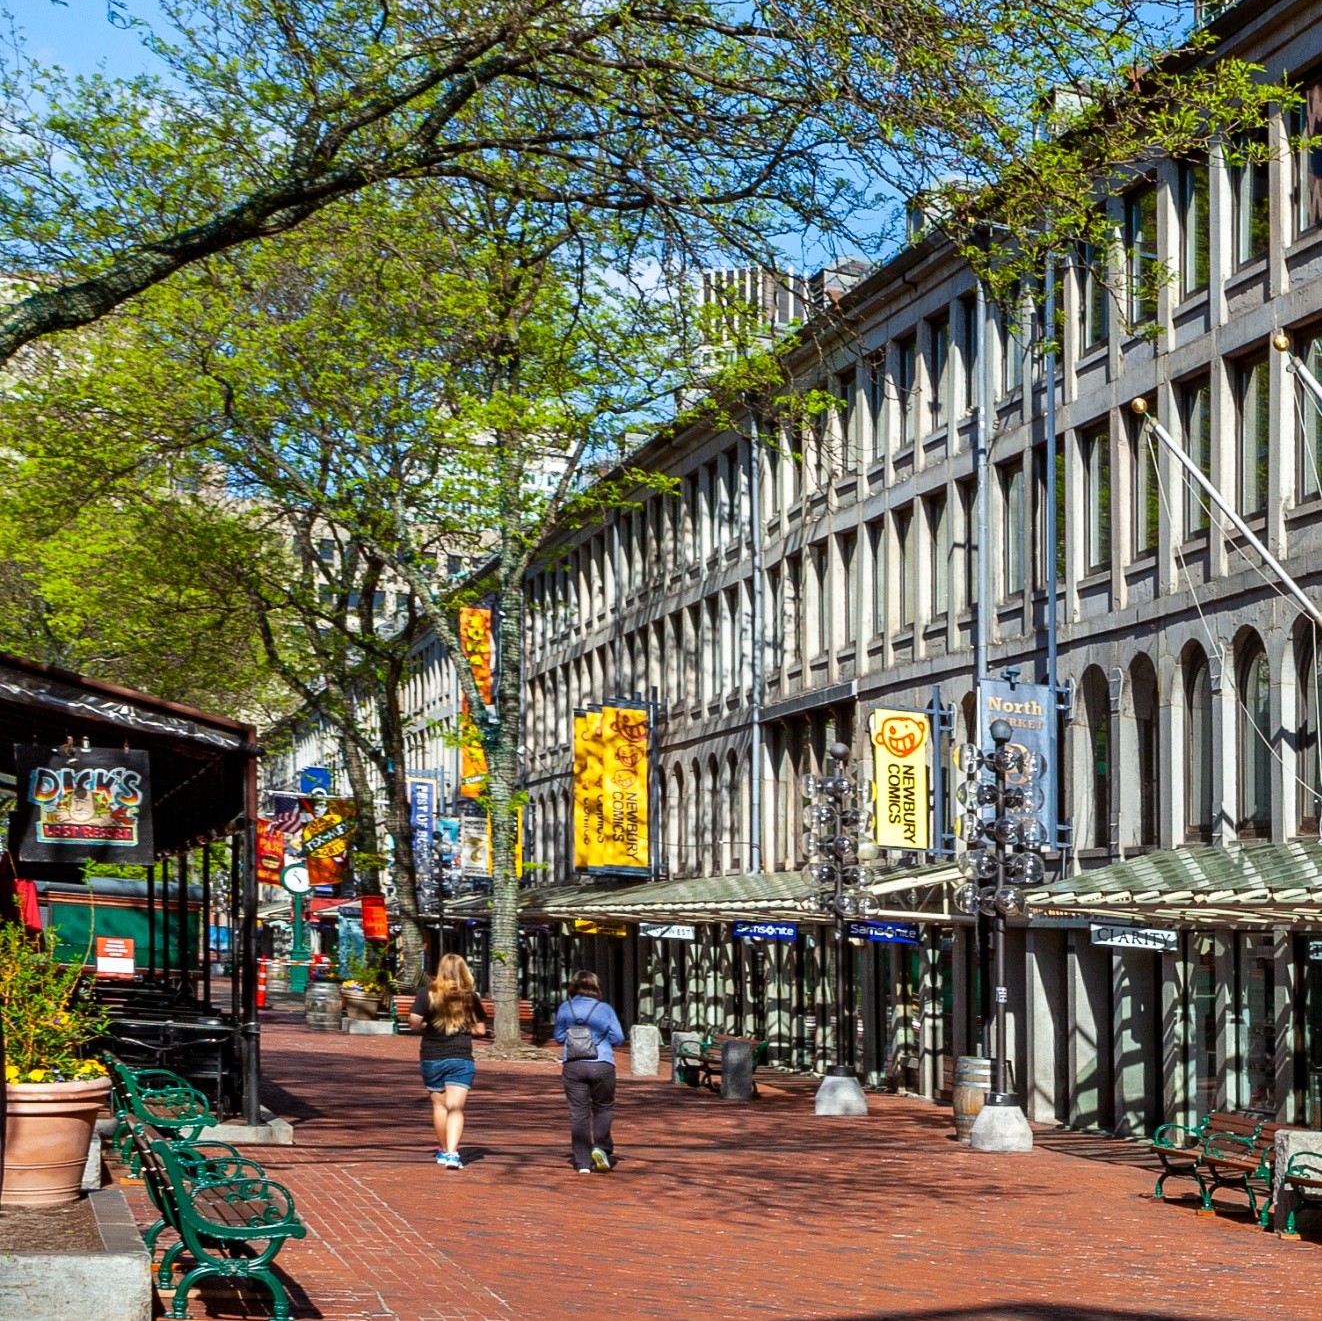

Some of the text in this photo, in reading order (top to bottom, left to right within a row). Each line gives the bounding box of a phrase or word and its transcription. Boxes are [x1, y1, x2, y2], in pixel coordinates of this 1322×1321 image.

[987, 696, 1044, 716] North
[988, 716, 1044, 729] RKET
[29, 767, 143, 807] DICK'S
[887, 763, 901, 824] COMICS
[903, 765, 916, 844] NEWBURY
[612, 791, 625, 842] COMICS
[626, 793, 639, 860] NEWBURY
[44, 824, 133, 839] LAST RESORT
[736, 923, 795, 936] Samsonite
[850, 924, 917, 939] Samsonite
[1097, 927, 1171, 947] CLARITY
